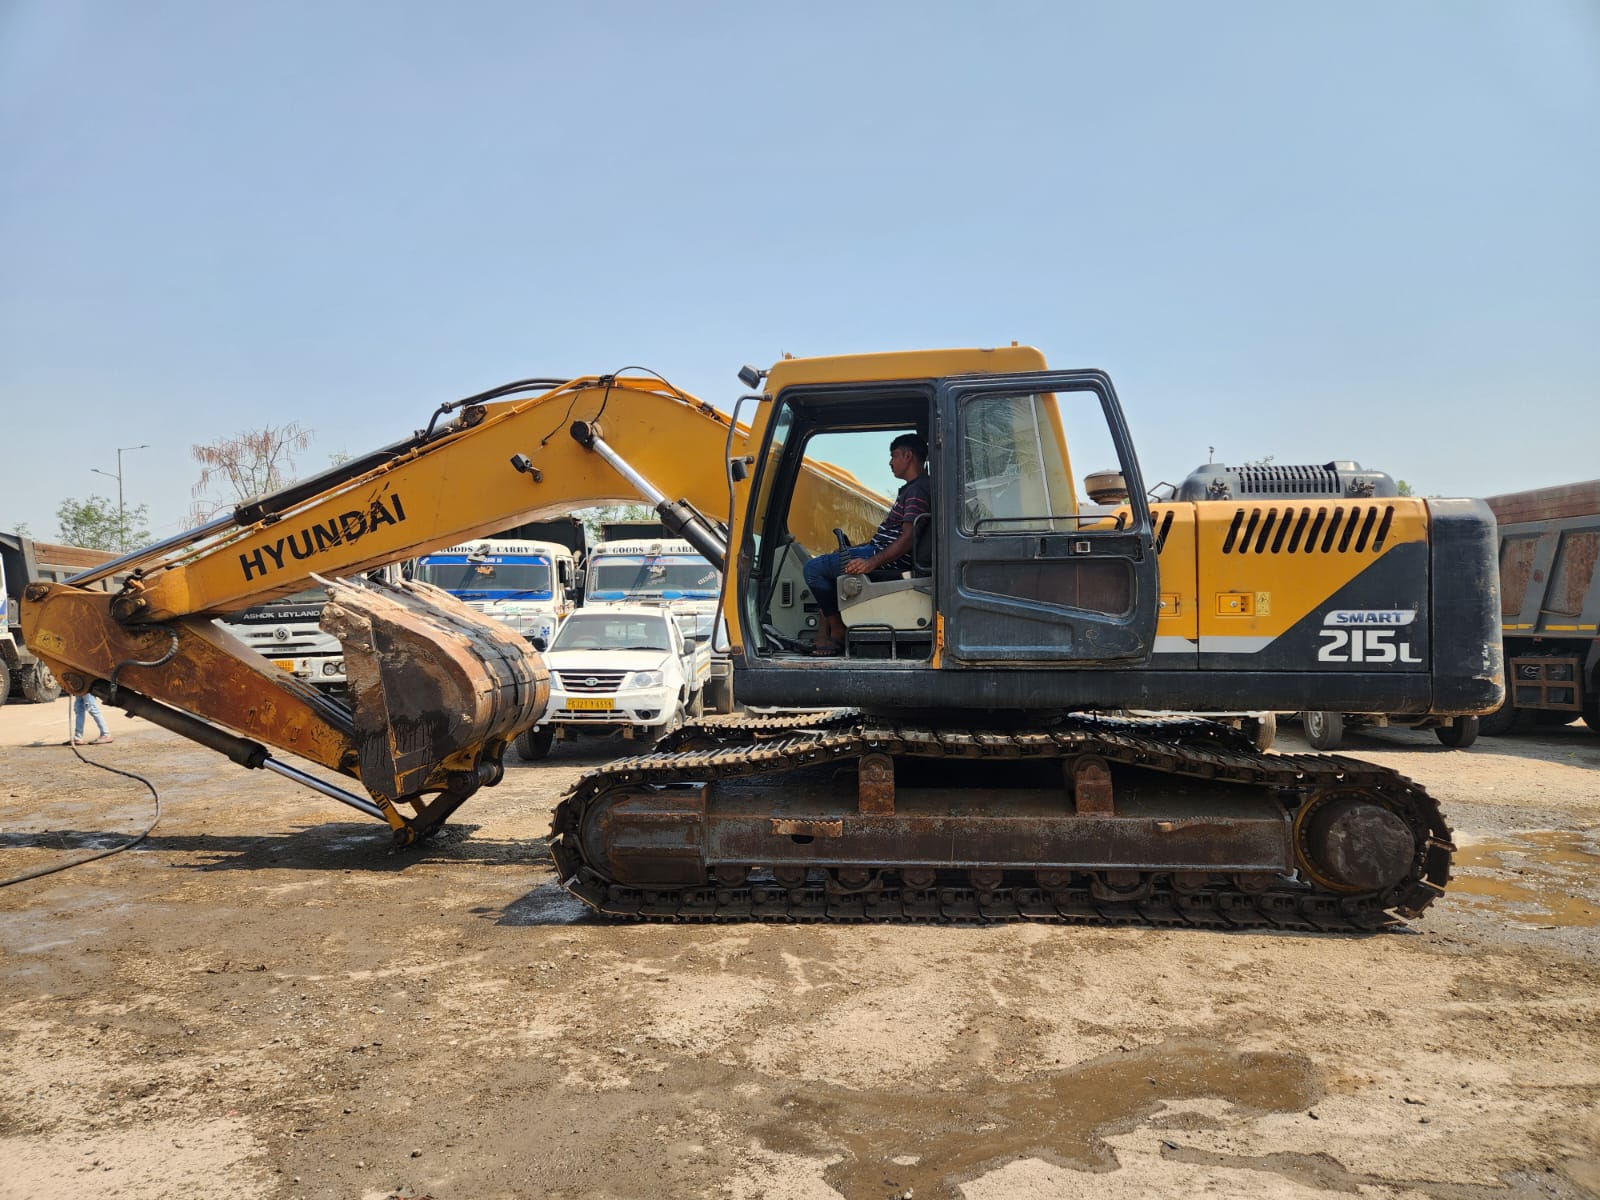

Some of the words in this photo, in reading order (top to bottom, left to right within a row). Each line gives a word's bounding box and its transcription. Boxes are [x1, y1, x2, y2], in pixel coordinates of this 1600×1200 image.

[239, 493, 406, 581] HYUNDAI
[670, 545, 695, 553] CARR
[243, 612, 274, 620] ASHOK
[278, 610, 320, 618] LEYLAND
[1336, 612, 1403, 623] SMART
